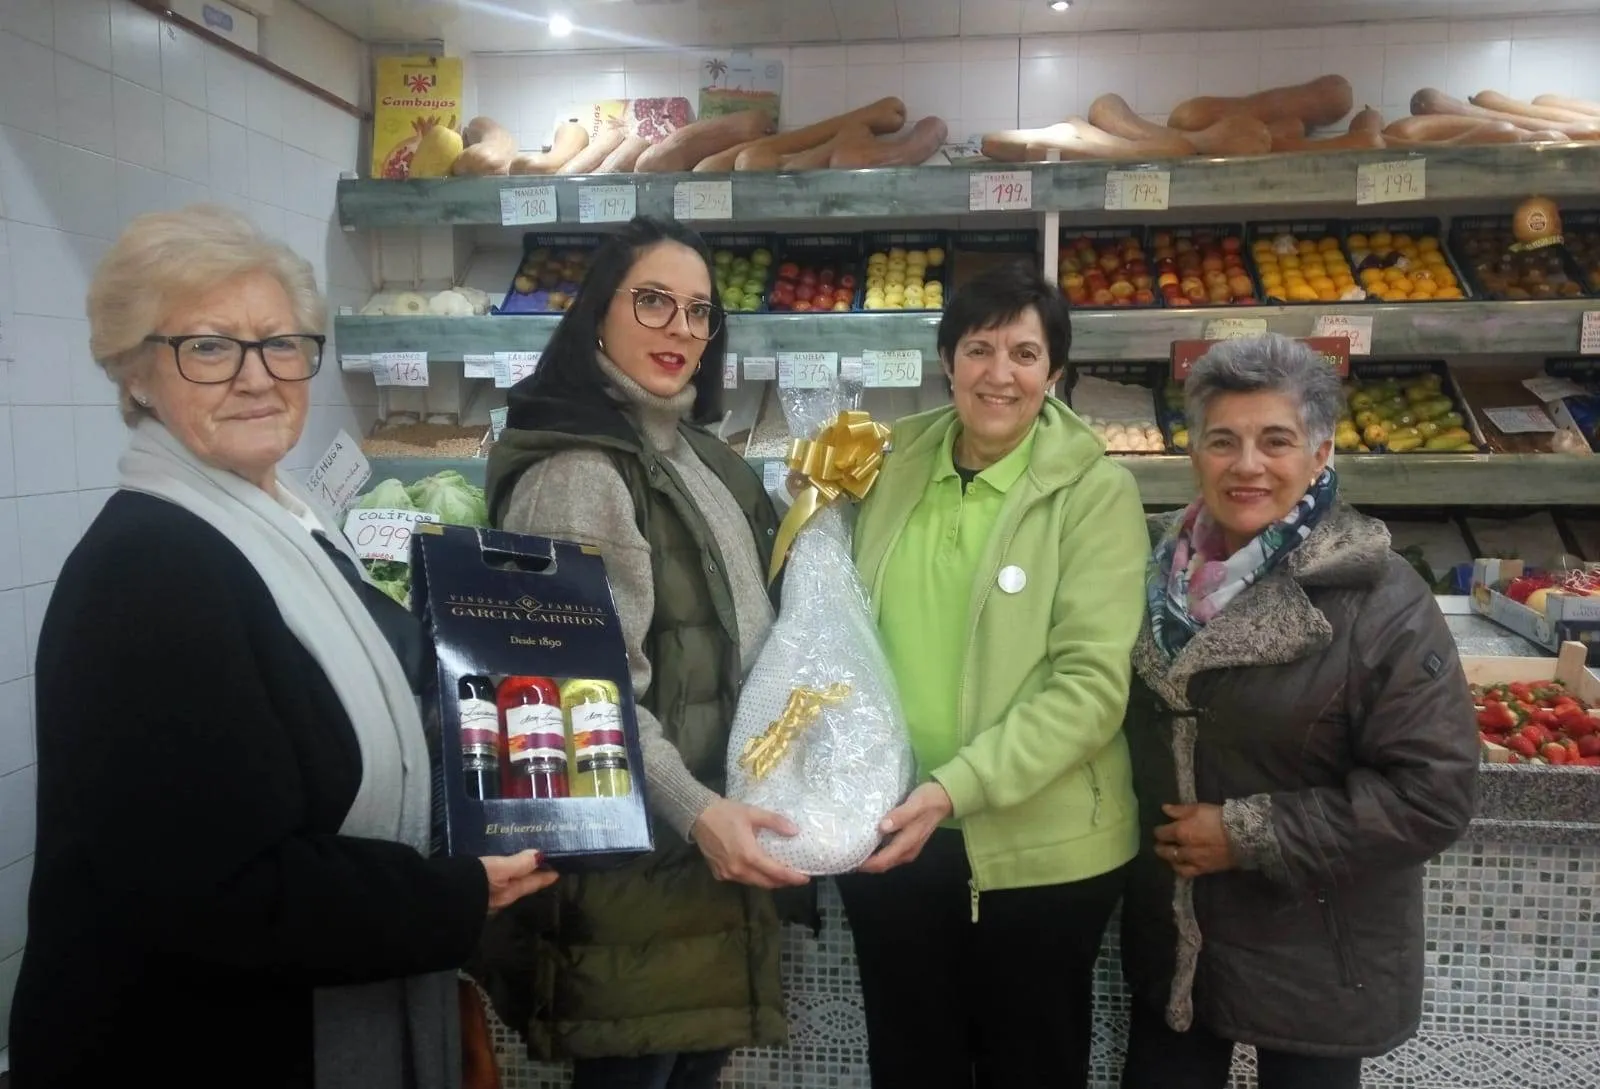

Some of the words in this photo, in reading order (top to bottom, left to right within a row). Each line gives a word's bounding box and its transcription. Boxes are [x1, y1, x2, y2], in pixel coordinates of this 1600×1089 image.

[382, 97, 456, 109] Cambayas
[450, 594, 493, 605] VINOS
[547, 603, 604, 614] FAMILIA
[451, 606, 521, 622] GARCIA
[525, 611, 605, 627] CARRION
[510, 634, 537, 646] Desde
[539, 637, 563, 649] 1890
[485, 823, 499, 836] El
[500, 822, 543, 836] esfuerzo
